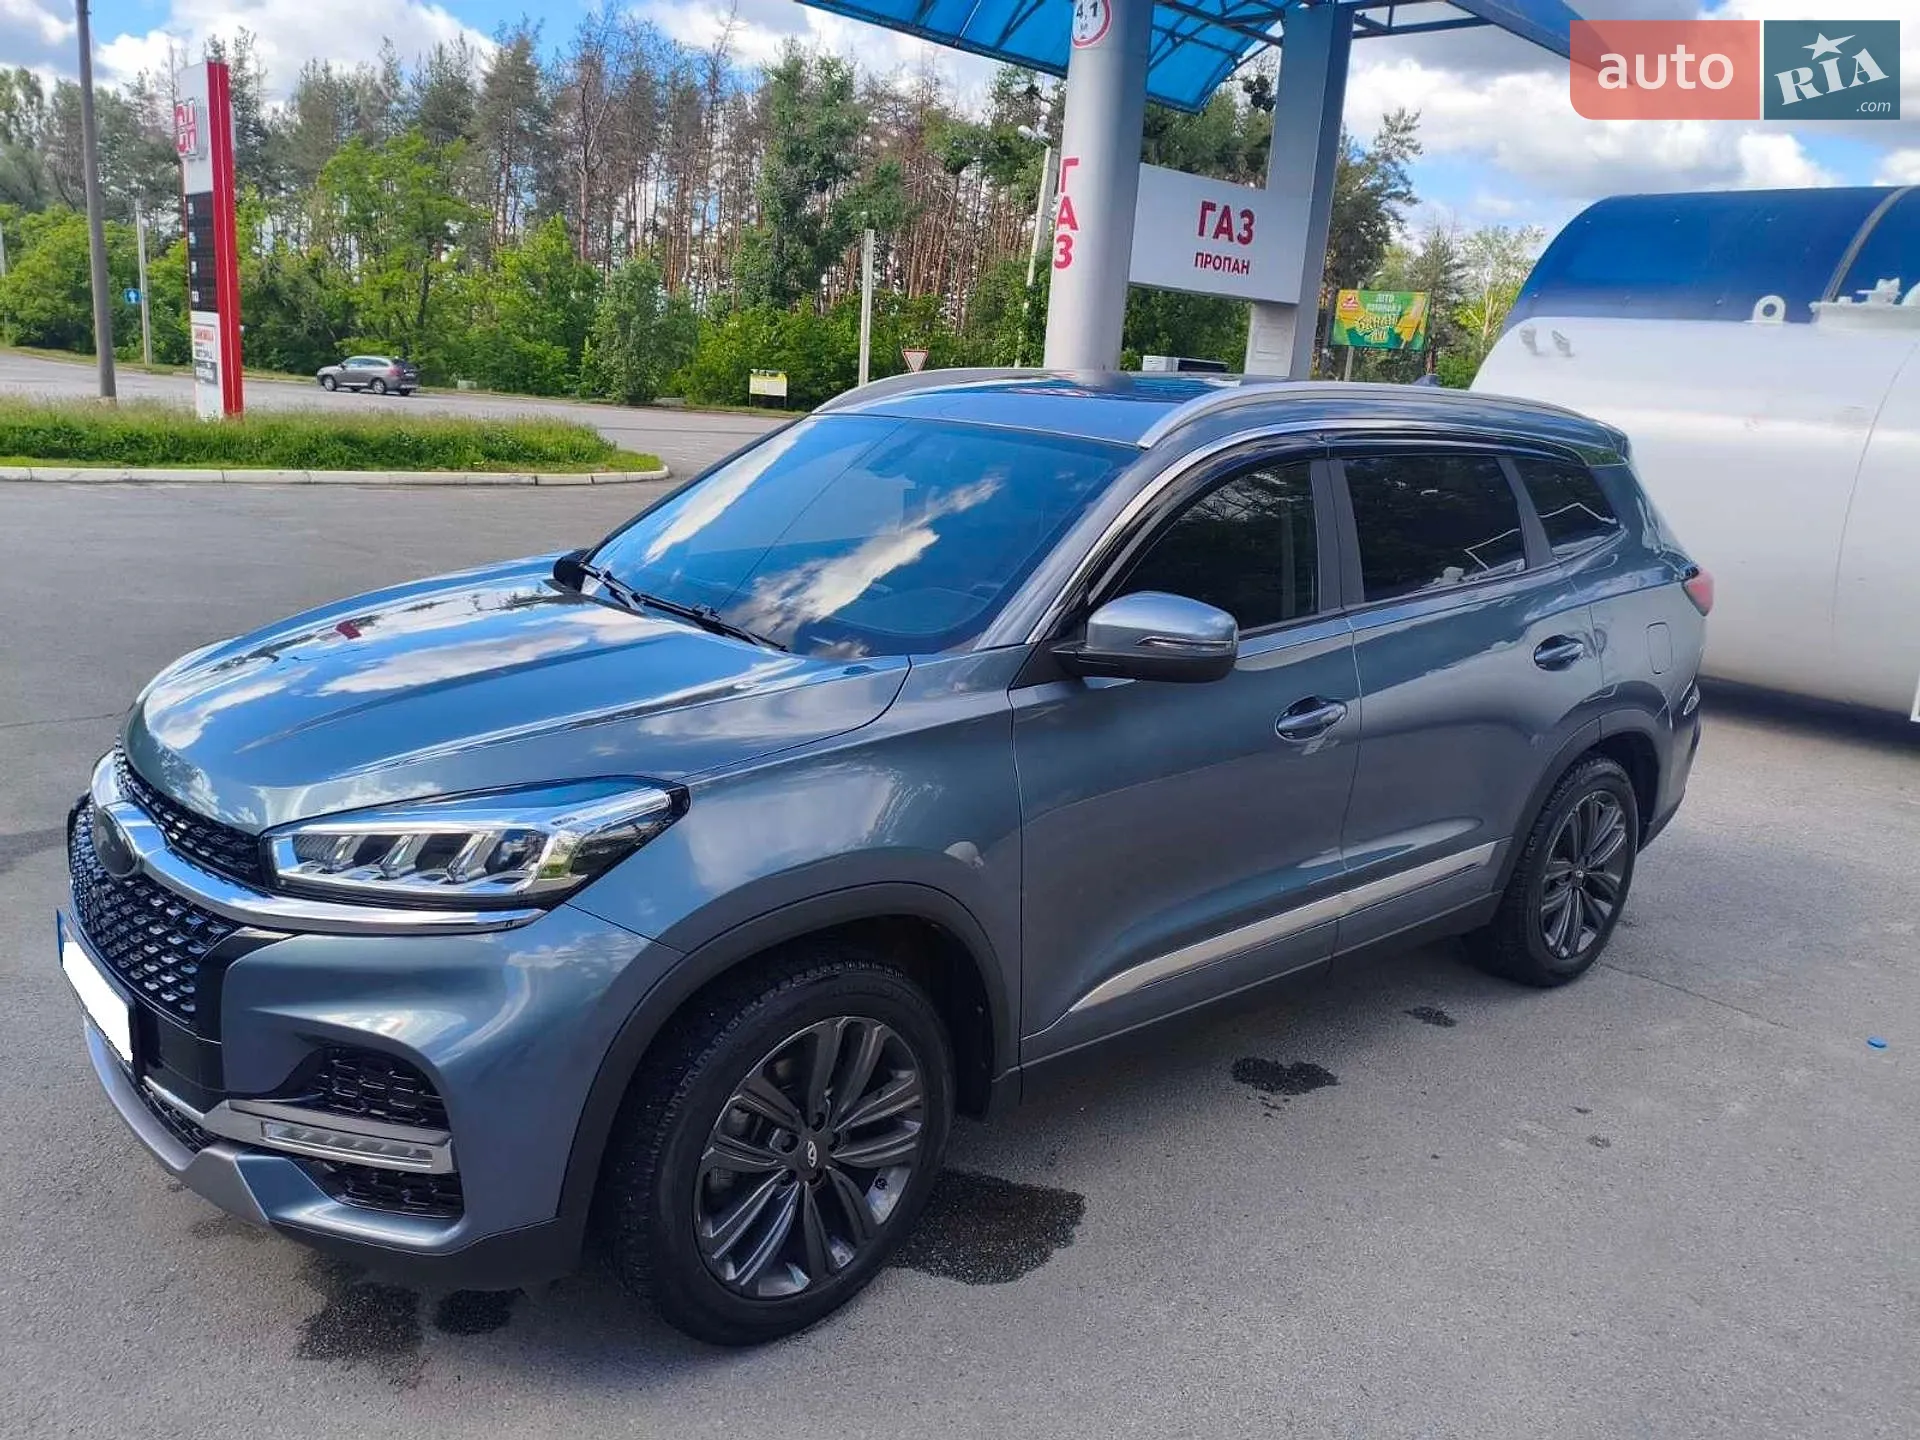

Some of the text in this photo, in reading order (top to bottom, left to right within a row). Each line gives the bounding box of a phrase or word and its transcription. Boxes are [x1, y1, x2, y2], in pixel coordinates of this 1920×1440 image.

[1054, 157, 1080, 269] ГАЗ
[1197, 200, 1256, 246] ГАЗ
[1194, 252, 1250, 275] ПРОПАН
